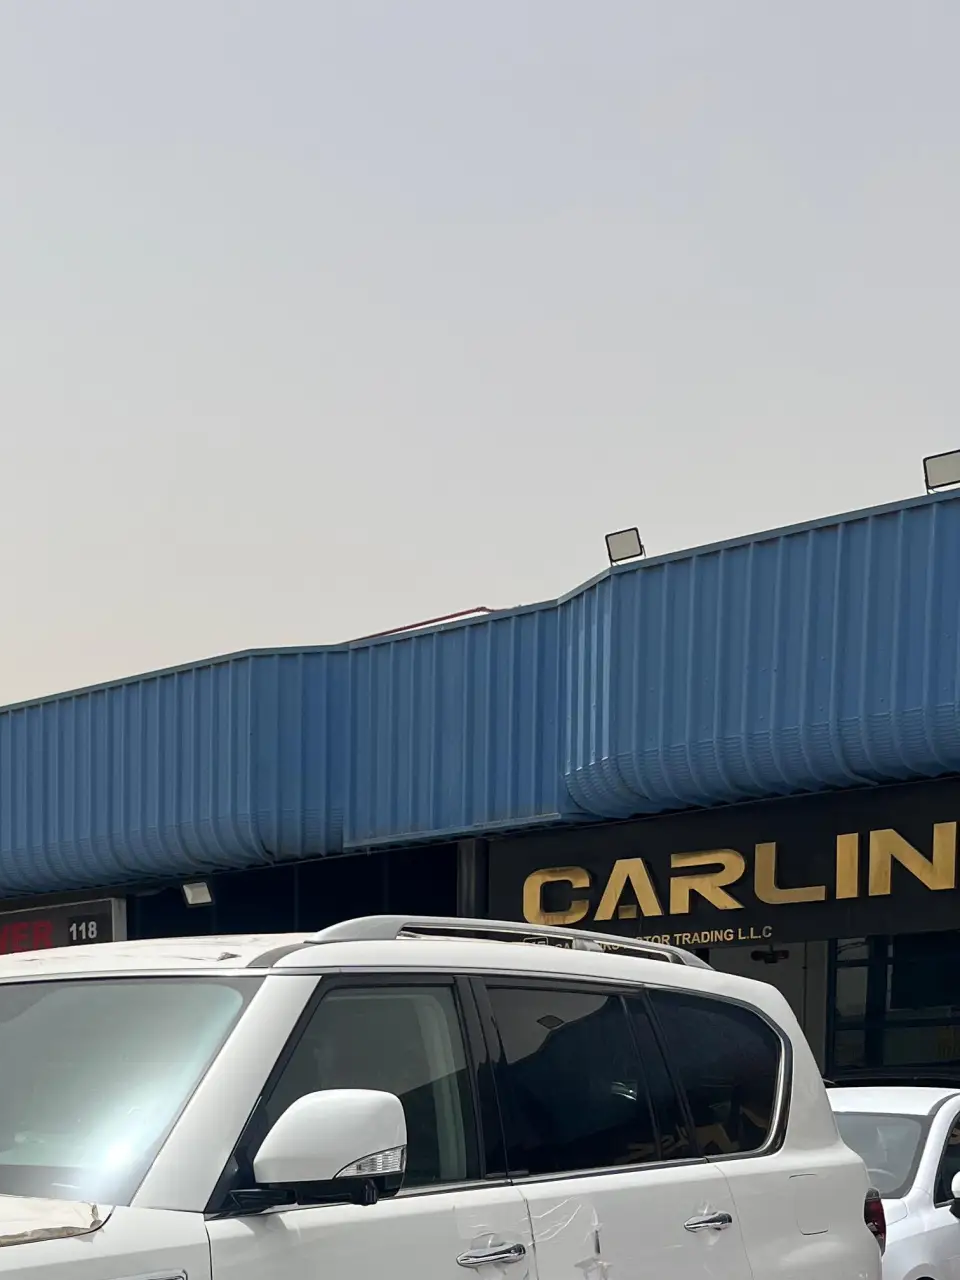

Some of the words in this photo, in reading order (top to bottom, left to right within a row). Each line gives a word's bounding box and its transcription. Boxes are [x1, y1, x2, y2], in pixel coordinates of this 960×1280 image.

[69, 921, 97, 941] 118
[673, 928, 734, 946] TRADING
[738, 925, 773, 940] L.L.C
